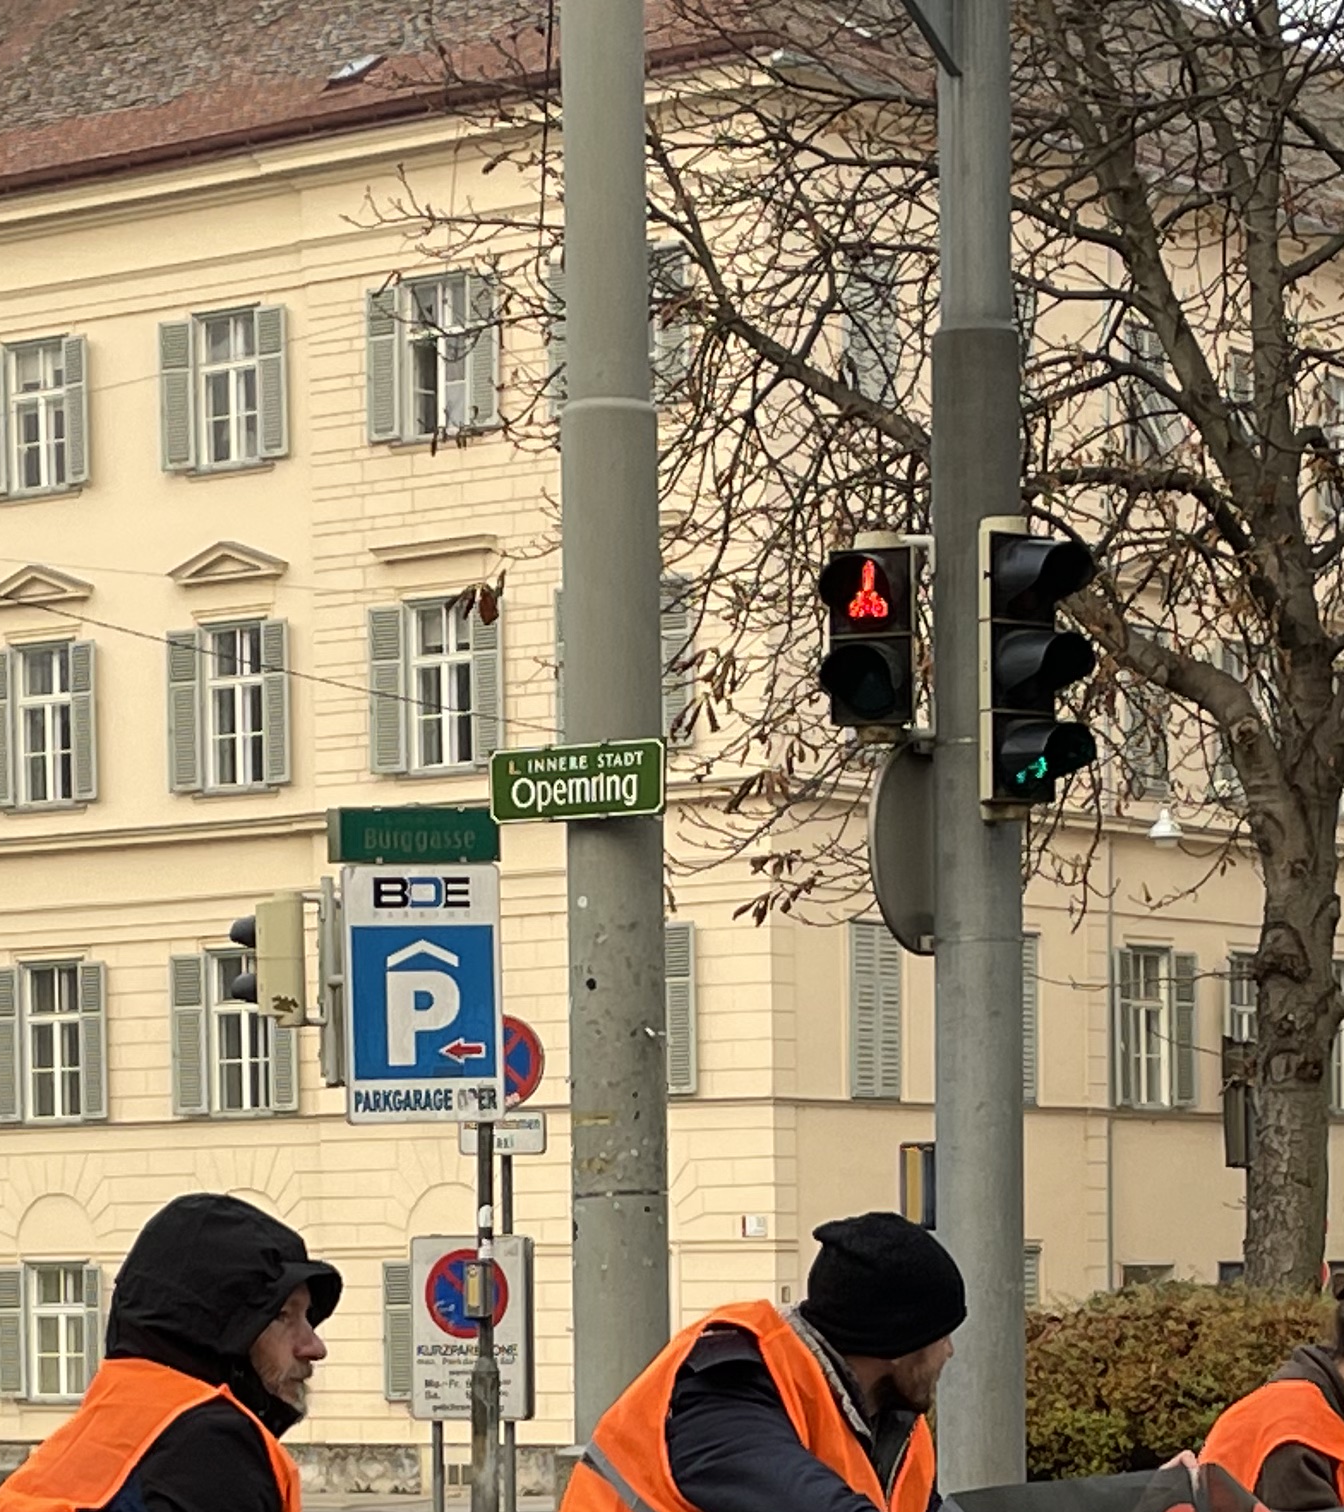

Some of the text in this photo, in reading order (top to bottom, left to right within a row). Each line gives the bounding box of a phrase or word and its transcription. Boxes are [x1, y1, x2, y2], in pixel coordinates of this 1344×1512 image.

[527, 755, 589, 774] INNERE
[597, 750, 644, 769] STADT
[511, 772, 639, 813] Opernring
[355, 1088, 454, 1113] PARKGARAGE
